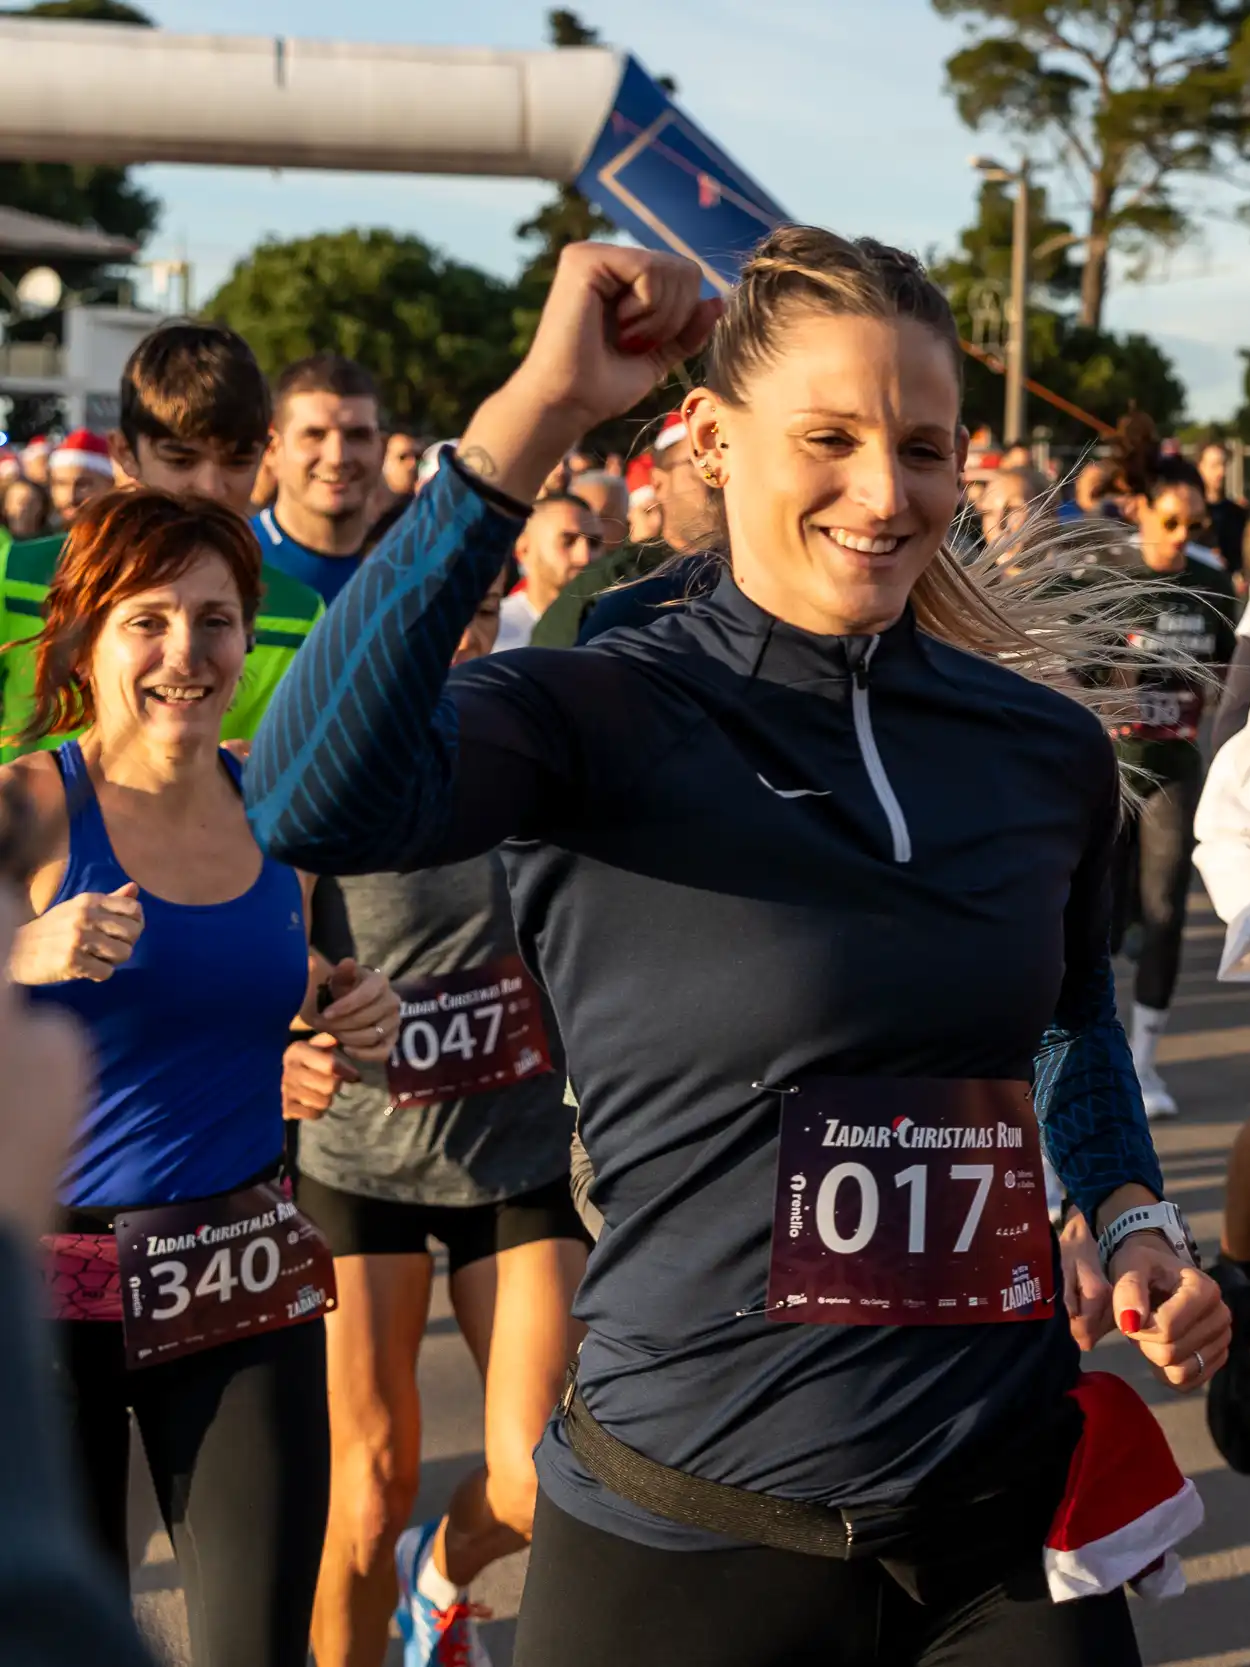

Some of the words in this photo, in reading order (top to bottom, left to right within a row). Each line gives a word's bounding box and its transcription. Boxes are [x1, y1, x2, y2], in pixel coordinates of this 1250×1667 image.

[401, 1003, 504, 1070] 047
[822, 1119, 891, 1148] ZADAR
[897, 1117, 993, 1149] CHRISTMAS
[996, 1121, 1022, 1149] RUN
[789, 1194, 804, 1239] rentlio
[816, 1162, 995, 1254] 017
[147, 1235, 197, 1257] ZADAR
[200, 1210, 277, 1246] CHRISTMAS
[150, 1236, 281, 1321] 340
[1000, 1279, 1036, 1312] ZADAR
